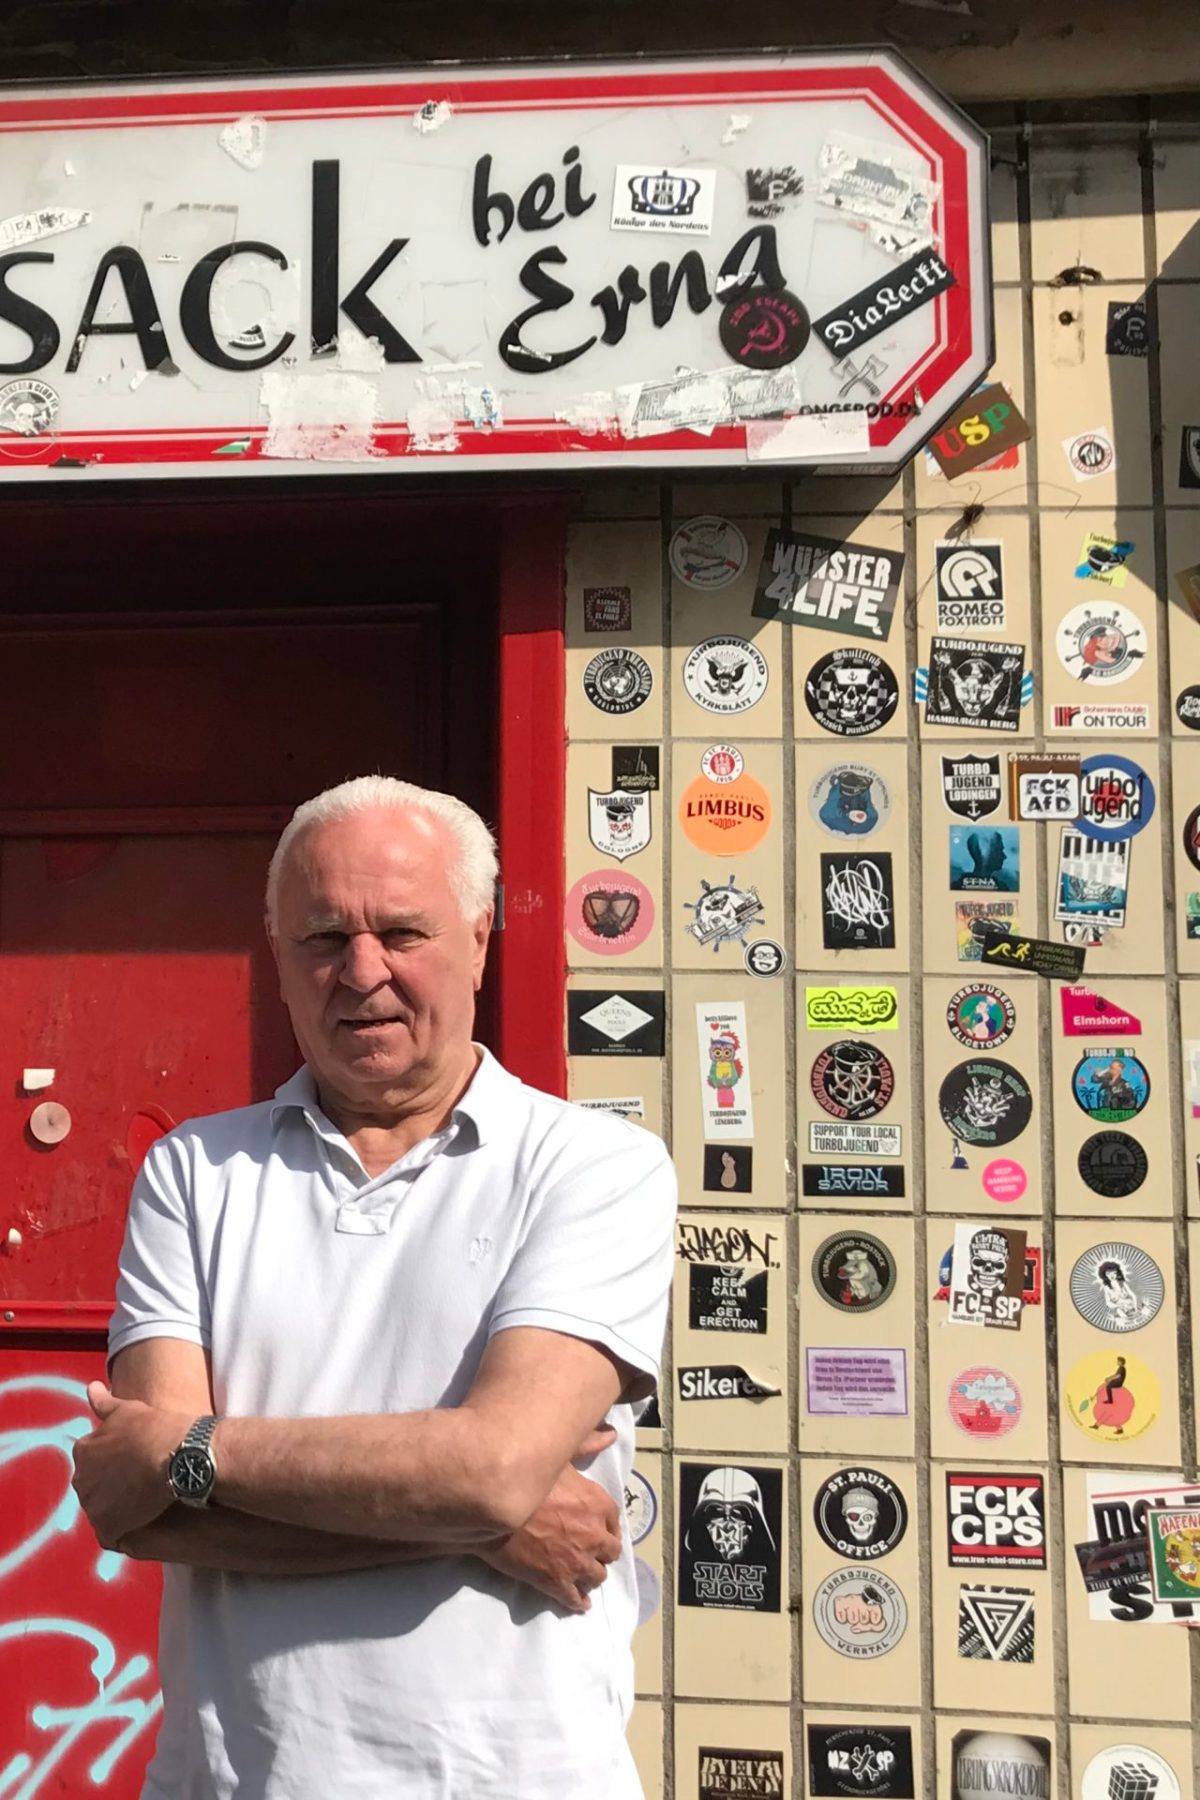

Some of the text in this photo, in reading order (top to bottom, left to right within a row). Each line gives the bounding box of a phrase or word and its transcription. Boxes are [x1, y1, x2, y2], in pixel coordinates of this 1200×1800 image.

[471, 145, 597, 248] bei
[649, 218, 666, 228] des
[499, 223, 788, 374] Erna
[931, 401, 1012, 459] USP
[938, 615, 1005, 627] FOXTROTT
[933, 638, 1024, 656] TURBOJUGEND
[687, 639, 766, 676] TURBOJUGEND
[926, 714, 1018, 731] HAMBURGER BERG
[1083, 715, 1147, 728] ON TOUR
[951, 763, 991, 775] TURBO
[951, 776, 993, 789] JUGEND
[1025, 778, 1072, 796] FCK
[595, 796, 645, 807] TURBOJUGEND
[1026, 795, 1073, 814] AfD
[686, 799, 765, 823] LIMBUS
[597, 840, 645, 853] COLOGNE
[950, 983, 1015, 1017] TURBOJUGEND
[1072, 1015, 1130, 1027] Elmshorn
[810, 1051, 850, 1120] TURBOJUGEND
[813, 1124, 898, 1140] SUPPORT YOUR LOCAL
[813, 1138, 880, 1153] TURBOJUGEND
[821, 1165, 884, 1183] IRON
[817, 1178, 889, 1192] SAVIOR
[822, 1239, 887, 1279] TURBOJUGEND ROSTOCK
[711, 1286, 747, 1298] CALM
[716, 1306, 742, 1318] GET
[953, 1290, 1022, 1320] FC SP
[699, 1315, 759, 1329] ERECTION
[827, 1471, 894, 1493] ST. PAULI
[950, 1483, 1042, 1517] FCK
[951, 1514, 1044, 1548] CPS
[835, 1538, 889, 1558] OFFICE
[952, 1556, 1044, 1566] www.true-rebel-store.com
[692, 1561, 767, 1584] START
[695, 1578, 764, 1602] RIOTS
[821, 1569, 896, 1597] TURBOJUGEND
